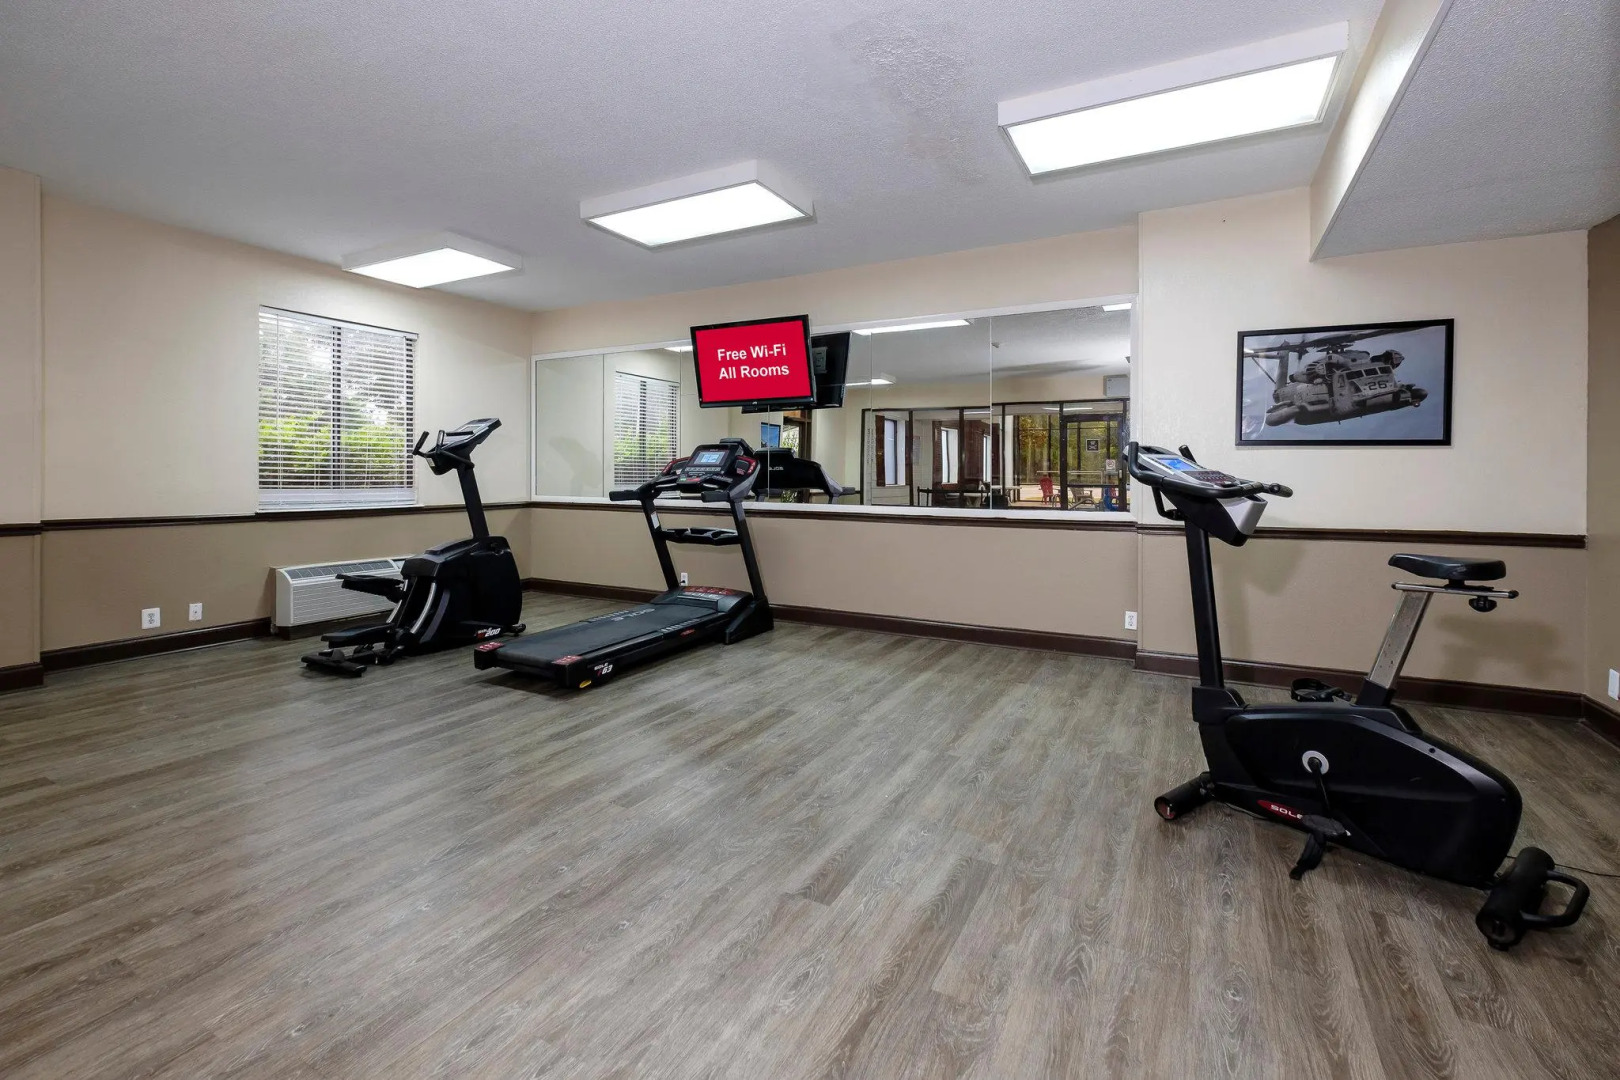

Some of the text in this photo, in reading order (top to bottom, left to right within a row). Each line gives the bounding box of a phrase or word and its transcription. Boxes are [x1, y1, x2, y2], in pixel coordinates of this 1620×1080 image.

[717, 343, 787, 362] Free Wi-Fi
[719, 364, 789, 380] All Rooms
[1367, 380, 1388, 391] 26
